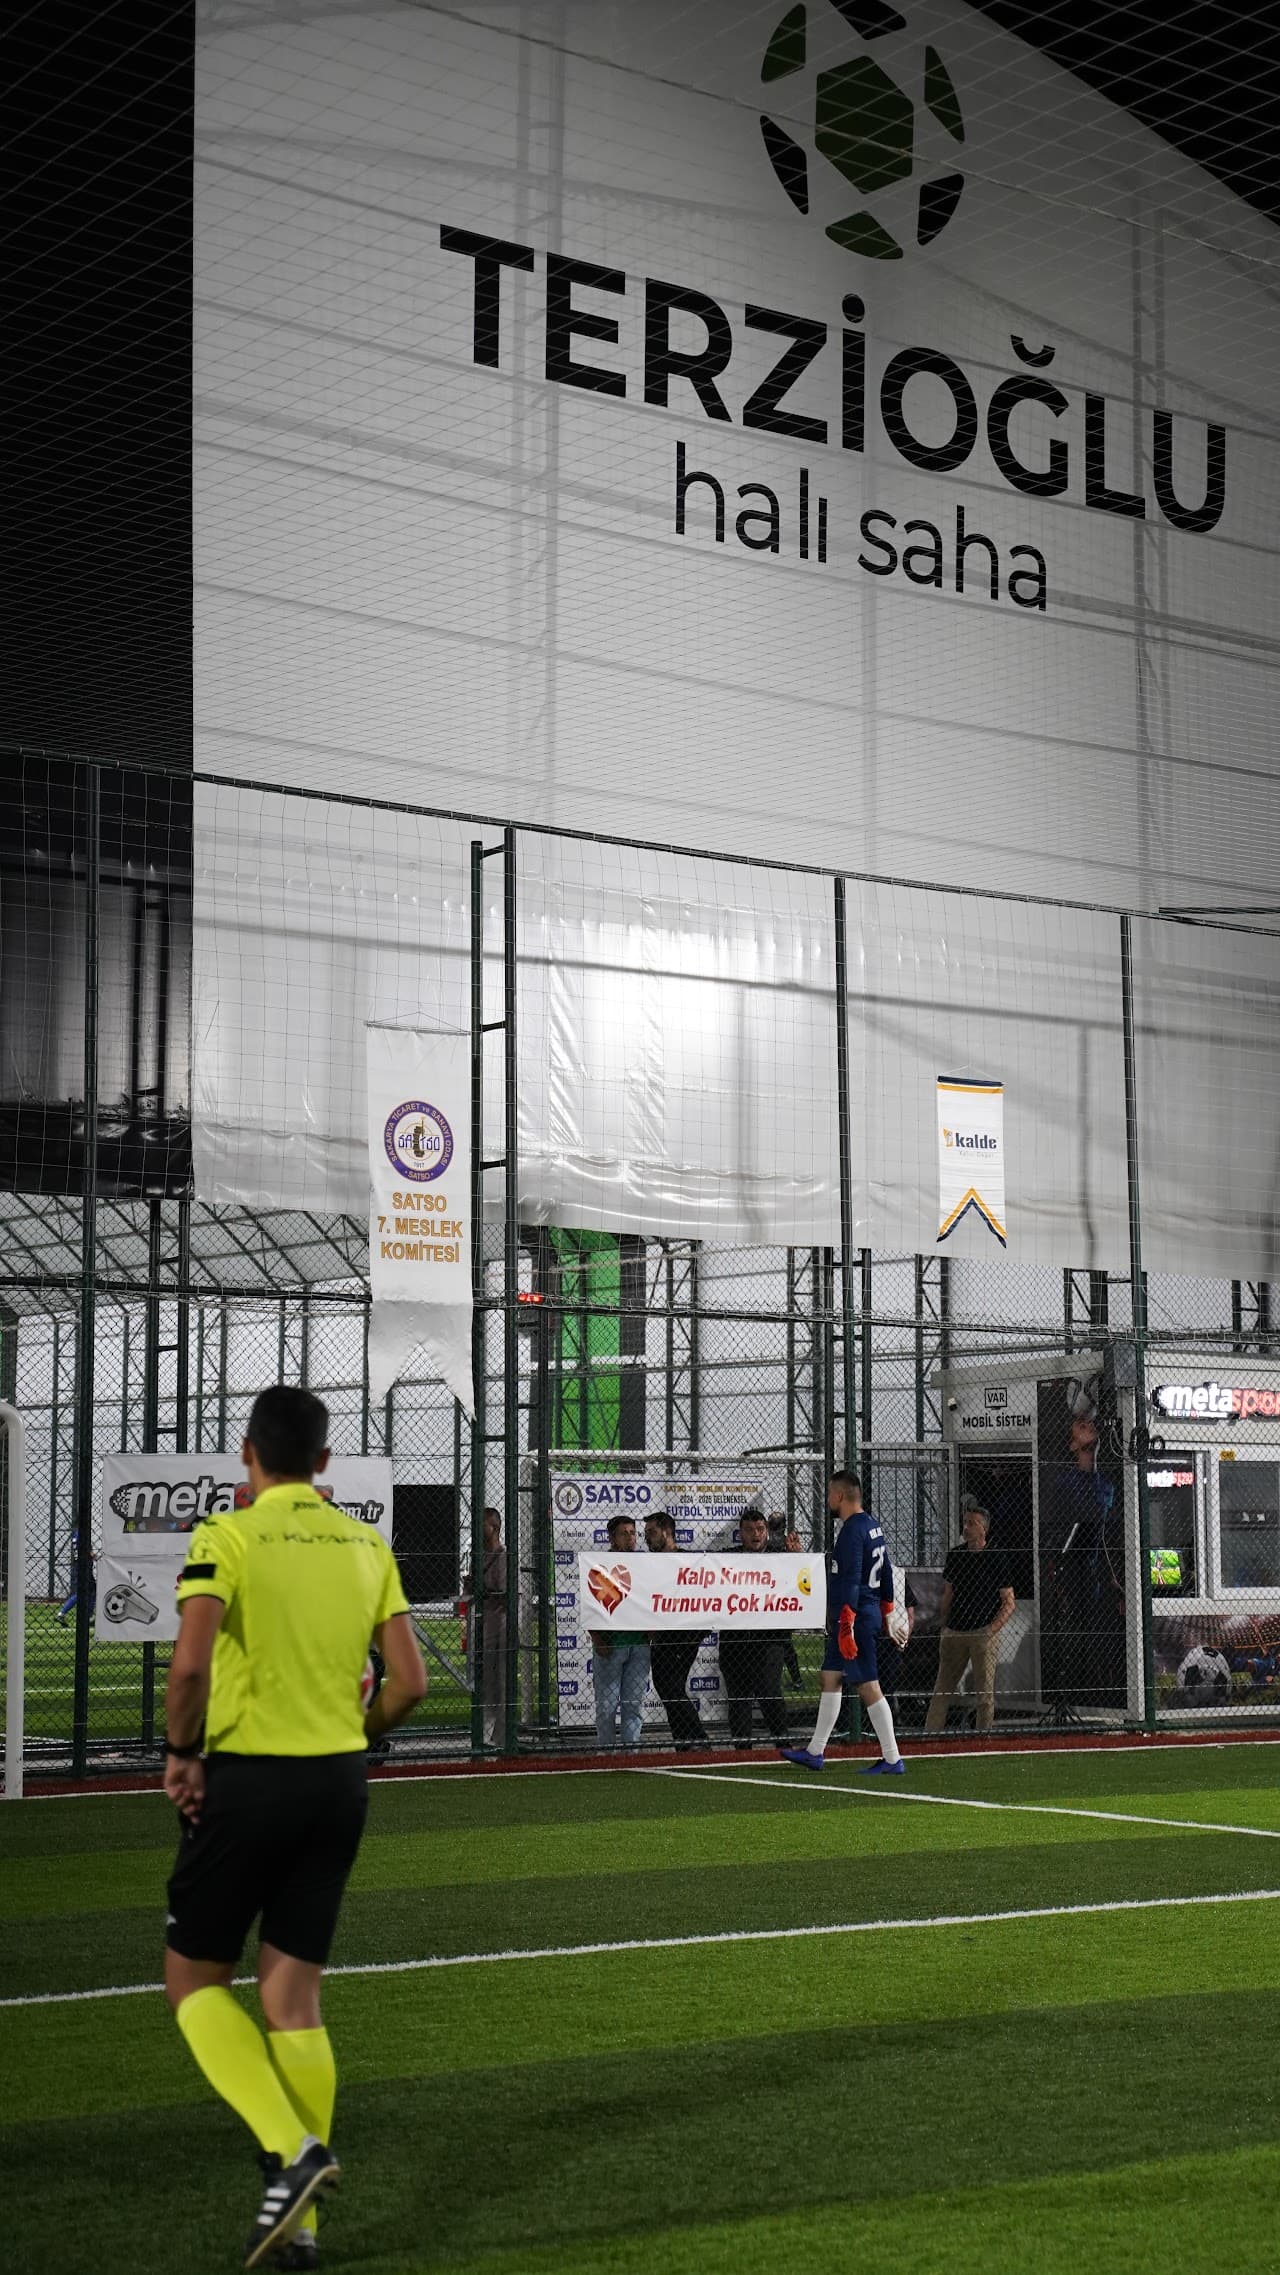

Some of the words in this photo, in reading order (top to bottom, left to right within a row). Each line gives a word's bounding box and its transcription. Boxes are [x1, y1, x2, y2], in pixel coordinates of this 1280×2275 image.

[440, 224, 1226, 533] TERZİOĞLU
[675, 441, 828, 564] halı
[858, 504, 1047, 612] saha
[955, 1132, 997, 1149] kalde
[392, 1192, 447, 1212] SATSO
[377, 1215, 391, 1233] 7.
[395, 1217, 463, 1238] MESLEK
[381, 1240, 460, 1263] KOMİTESİ
[987, 1392, 1005, 1402] VAR
[962, 1412, 994, 1428] MOBİL
[996, 1412, 1031, 1427] SİSTEM
[585, 1485, 651, 1504] SATSO
[666, 1506, 702, 1517] FUTBOL
[676, 1566, 715, 1589] Kalp
[720, 1567, 776, 1589] Kırma,
[555, 1595, 573, 1605] tek
[652, 1594, 722, 1613] Turnuva
[726, 1593, 760, 1615] Çok
[763, 1593, 803, 1612] Kısa.
[558, 1639, 573, 1647] tek
[559, 1684, 575, 1693] tek
[692, 1679, 717, 1689] altek
